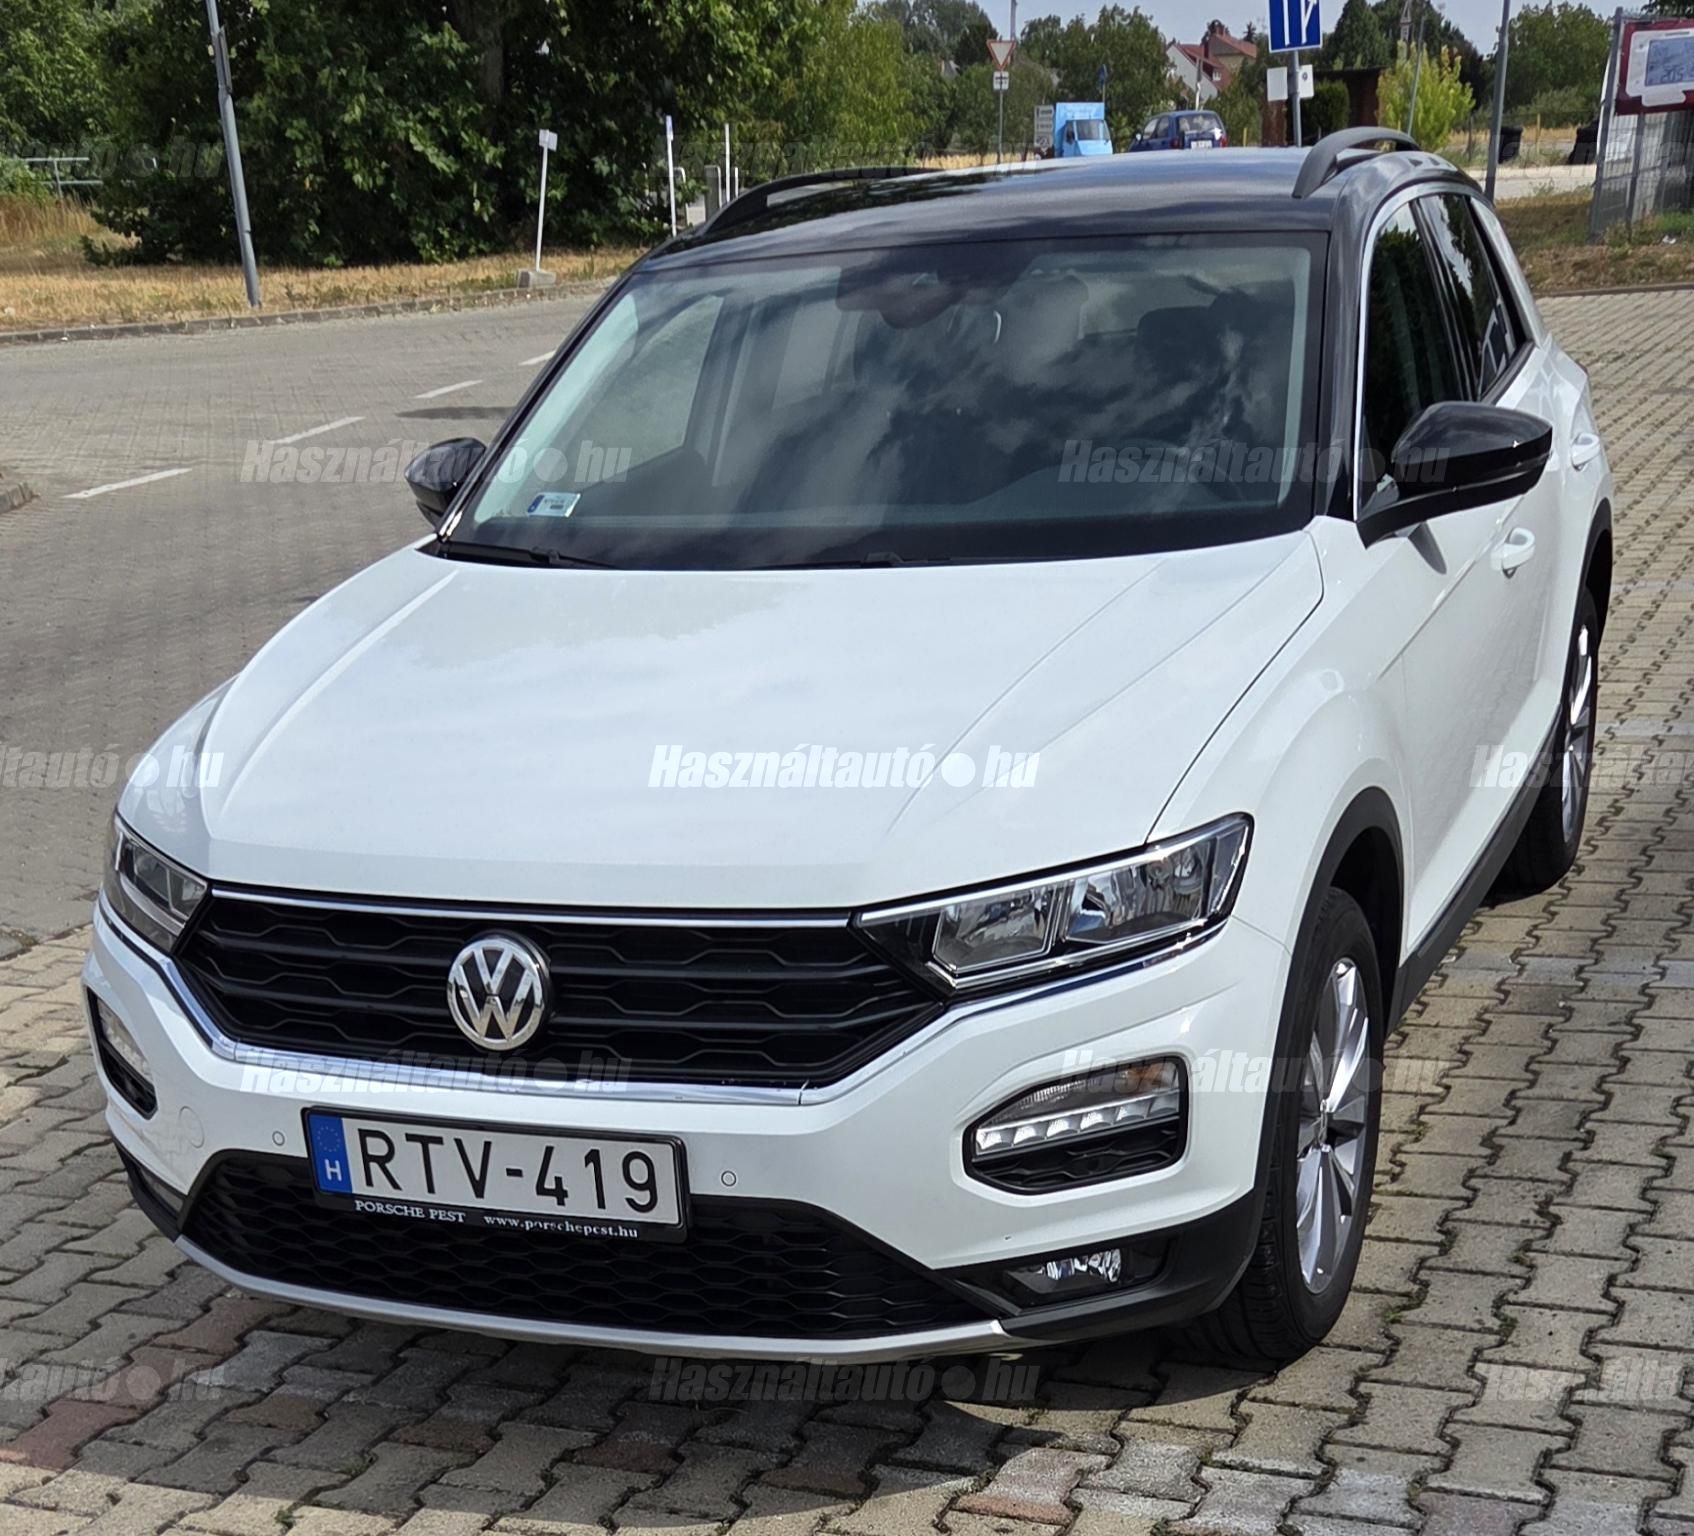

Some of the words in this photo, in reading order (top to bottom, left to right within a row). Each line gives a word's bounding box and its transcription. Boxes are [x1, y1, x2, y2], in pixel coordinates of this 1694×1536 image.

[324, 1158, 342, 1181] H
[357, 1127, 659, 1214] RTV-419
[354, 1199, 425, 1219] PORSCHE
[429, 1208, 467, 1223] PEST
